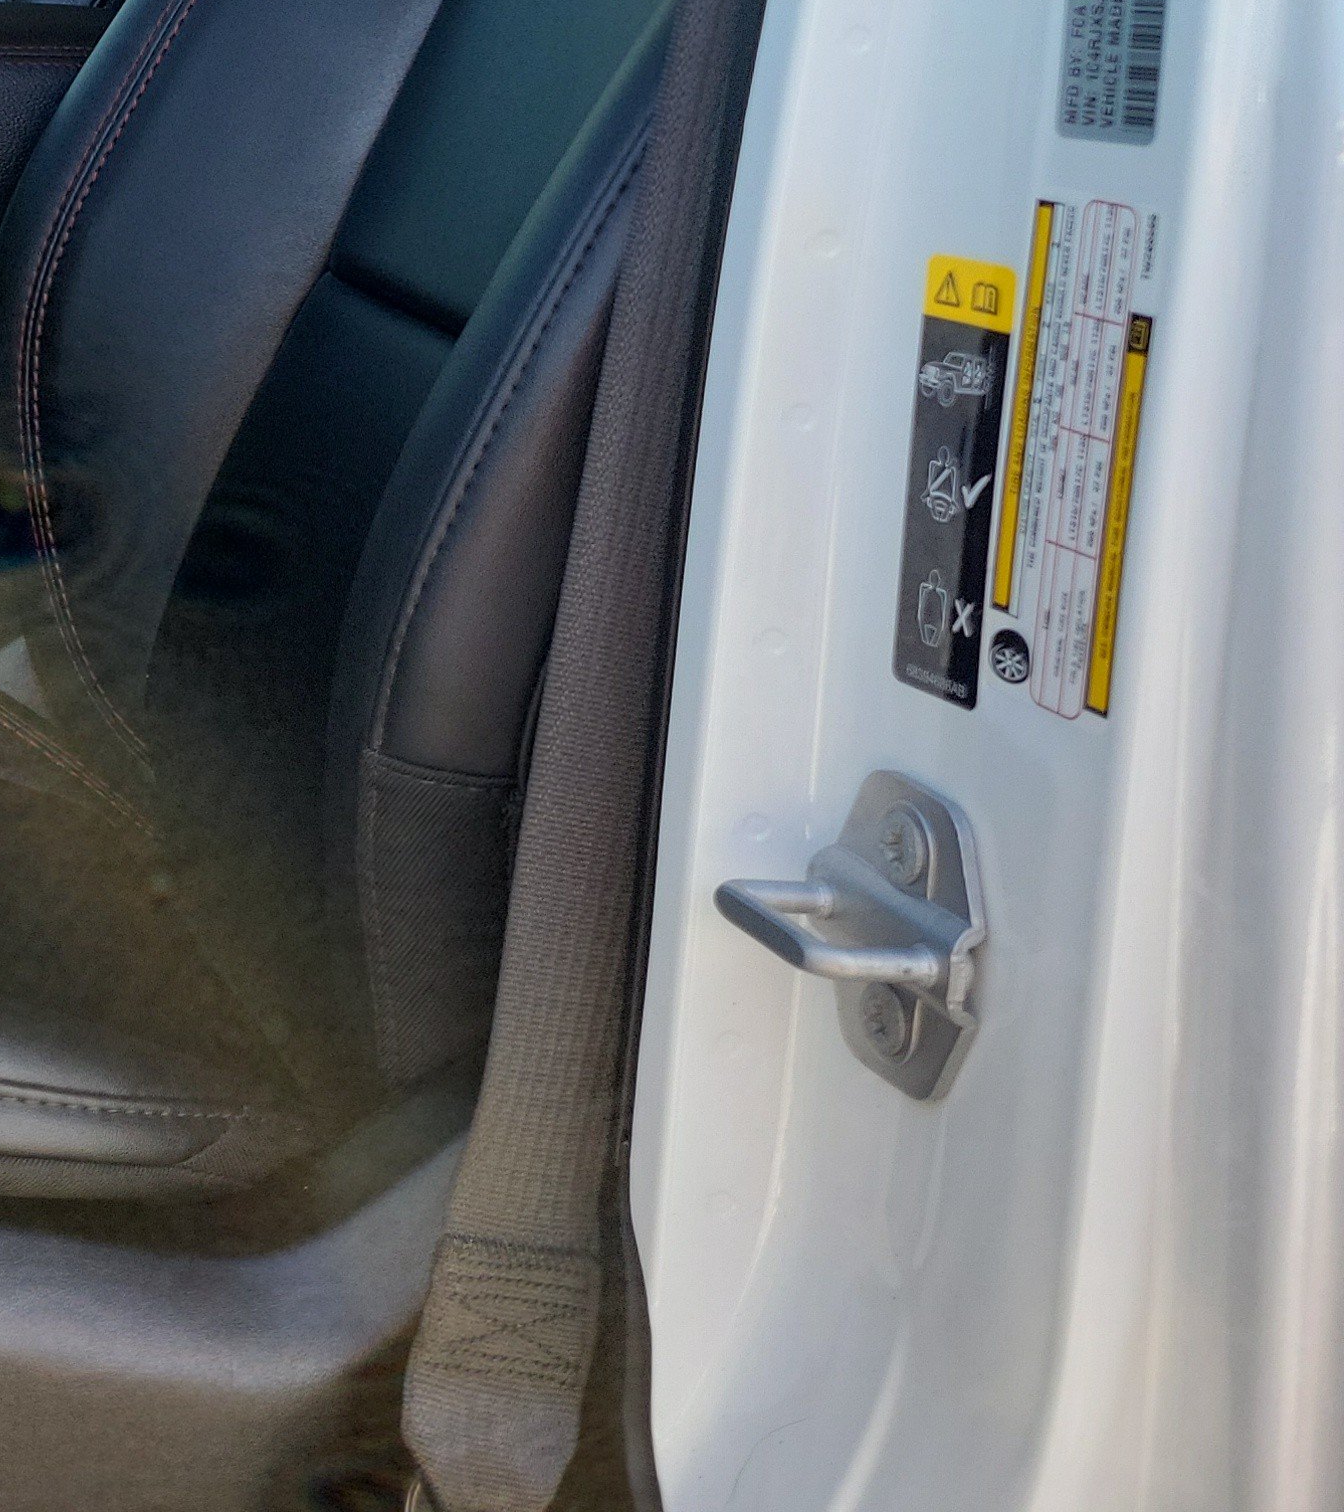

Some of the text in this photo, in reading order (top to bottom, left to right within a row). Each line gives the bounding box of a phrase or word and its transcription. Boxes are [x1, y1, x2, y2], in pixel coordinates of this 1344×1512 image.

[1071, 4, 1086, 39] FCA
[1064, 85, 1079, 126] MFD
[1100, 53, 1119, 129] VEHICLE
